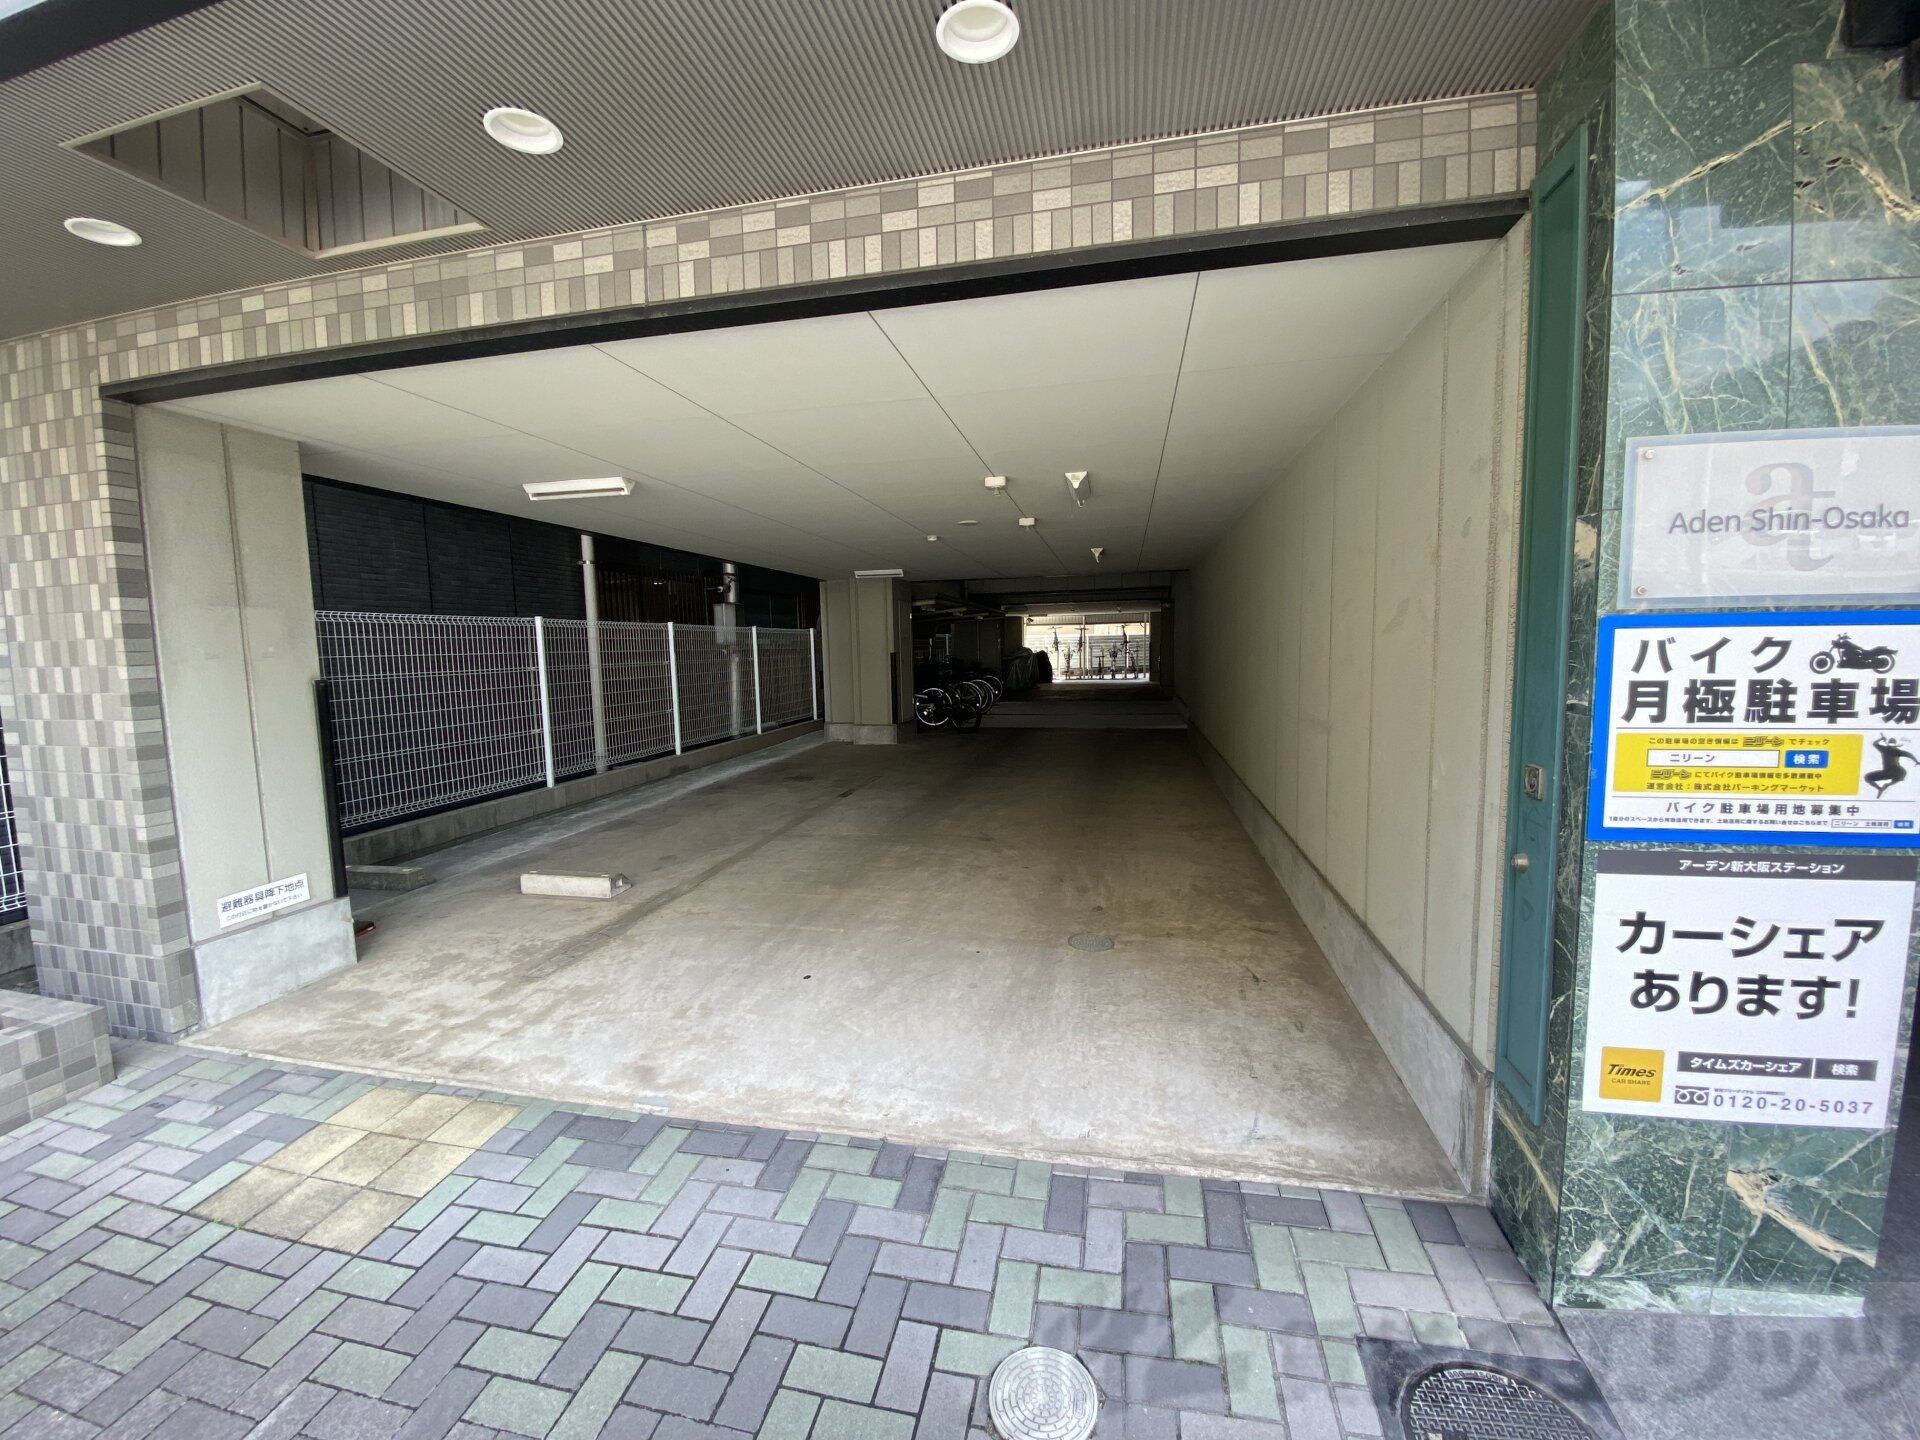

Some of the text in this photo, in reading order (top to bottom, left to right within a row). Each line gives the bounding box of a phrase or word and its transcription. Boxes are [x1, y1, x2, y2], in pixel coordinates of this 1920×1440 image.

[1668, 504, 1910, 534] Aden Shin-Osaka
[1630, 636, 1793, 675] バイク
[1621, 678, 1920, 725] 月極駐車場
[1669, 752, 1821, 766] ニリーン 検索
[1679, 859, 1846, 875] アーデン新大阪ステーション
[1615, 911, 1886, 963] カーシェア
[1629, 969, 1861, 1020] あります!
[1607, 1063, 1657, 1078] Times
[1690, 1056, 1859, 1077] タイムズカーシェア 検索
[1713, 1095, 1874, 1115] 0120-20-5037
